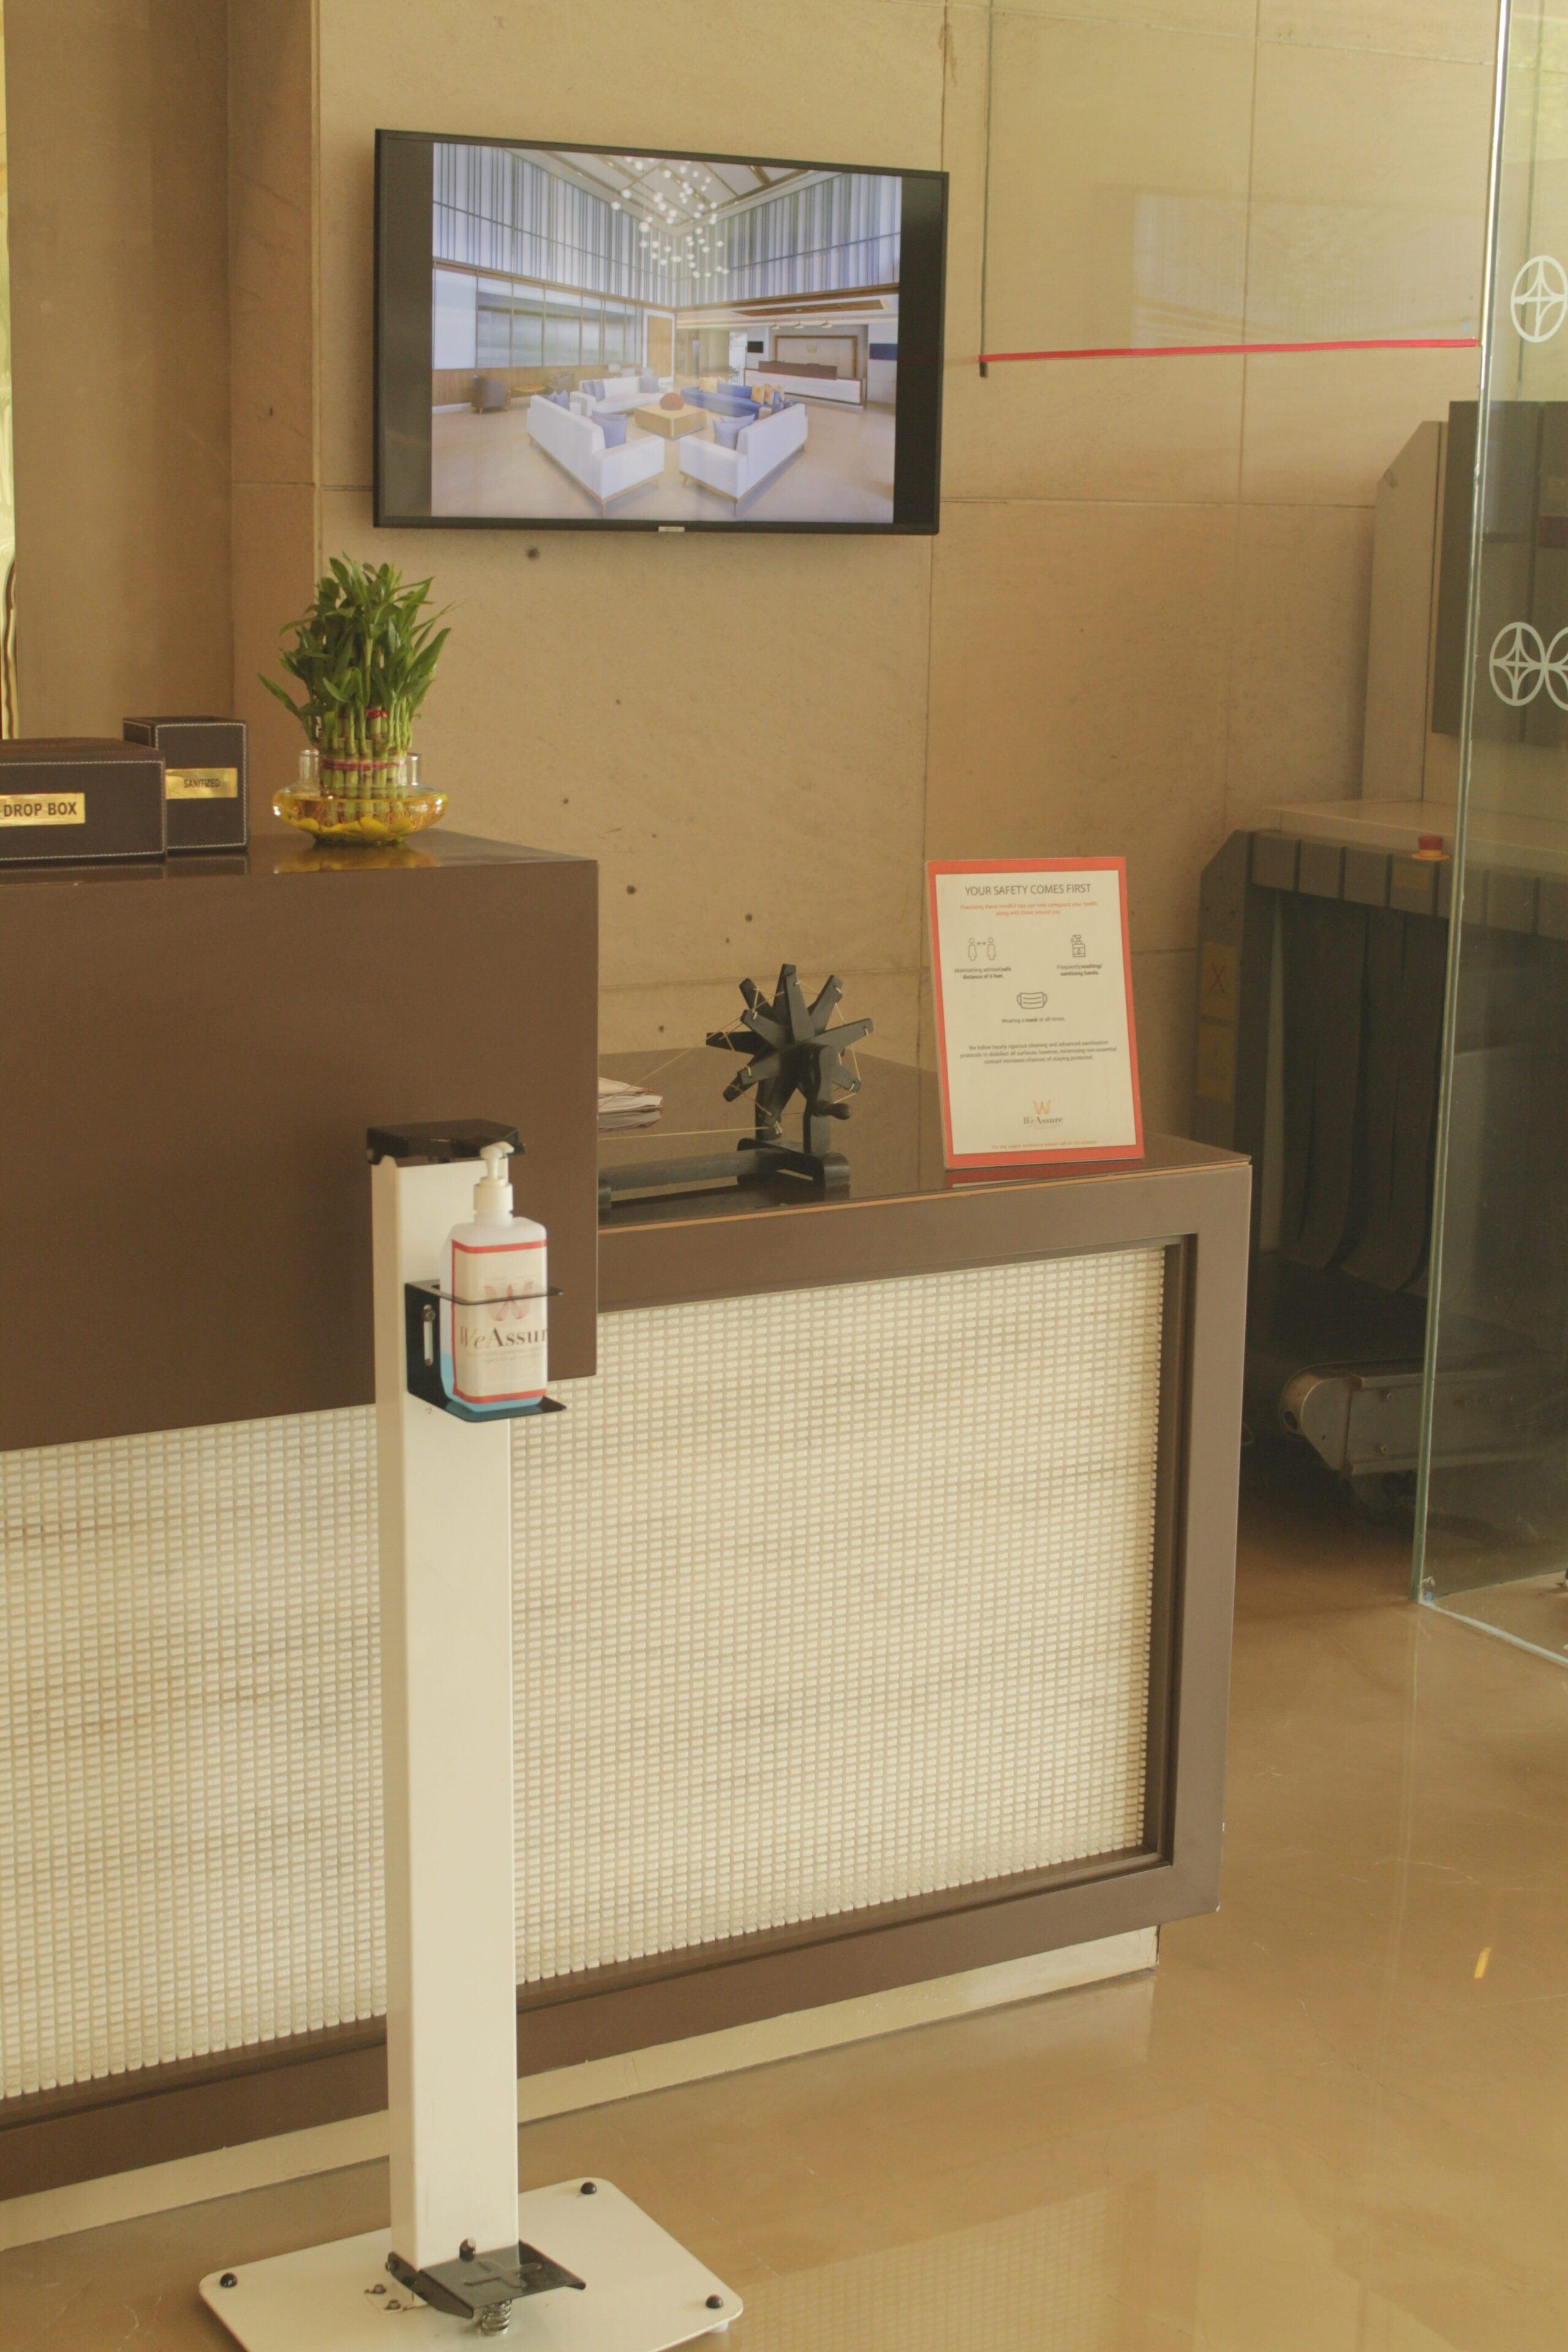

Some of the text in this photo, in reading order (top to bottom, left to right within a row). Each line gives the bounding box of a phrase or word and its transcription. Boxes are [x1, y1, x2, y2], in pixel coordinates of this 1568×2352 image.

[184, 778, 220, 788] SANITIZED
[4, 801, 77, 817] DROP BOX
[965, 883, 1091, 895] YOUR SAFETY COMES FIRST
